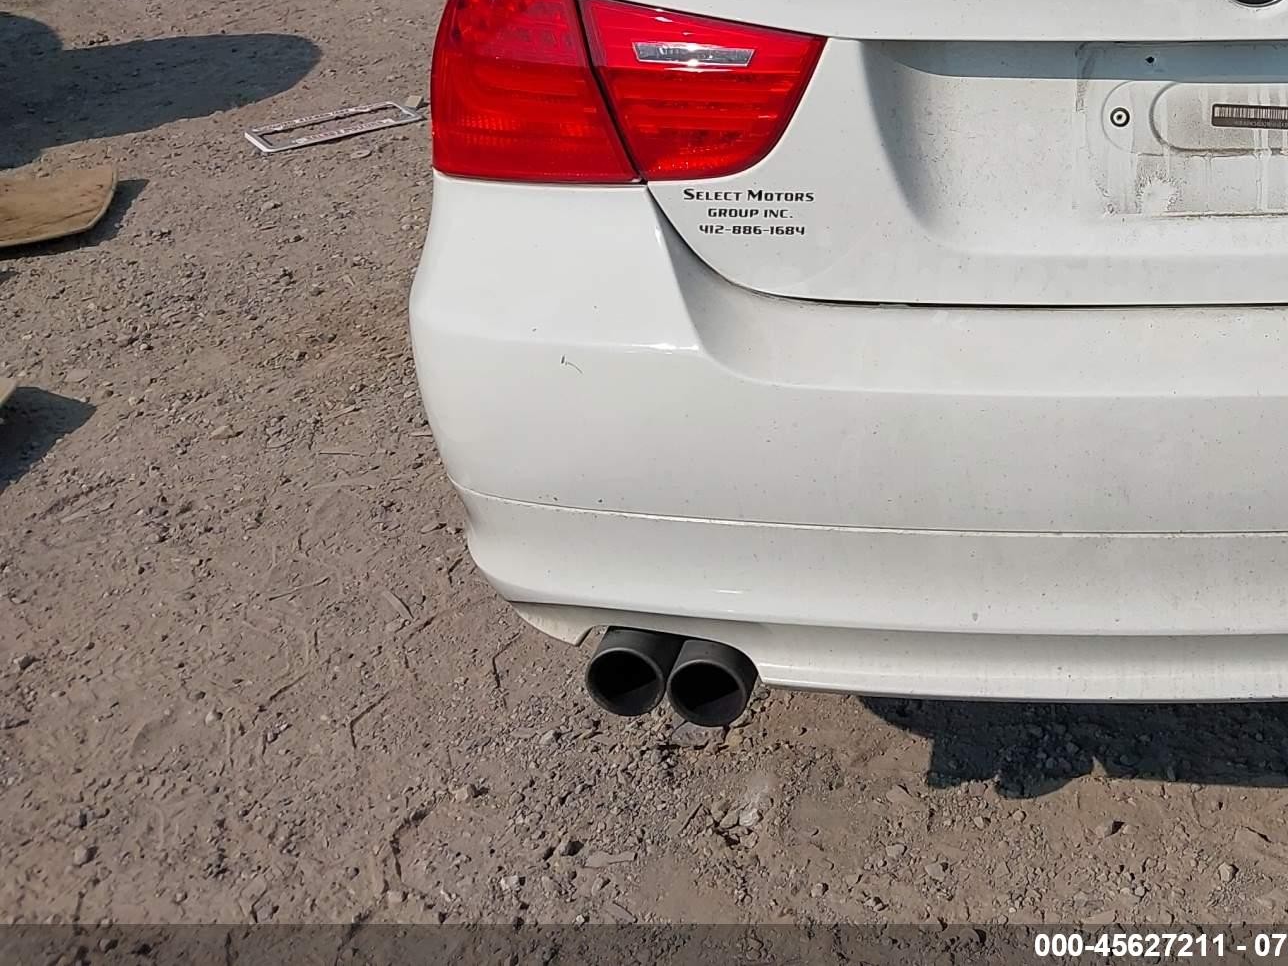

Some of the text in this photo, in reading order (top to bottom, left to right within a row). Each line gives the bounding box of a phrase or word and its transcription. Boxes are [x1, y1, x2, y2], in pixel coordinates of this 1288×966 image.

[707, 208, 793, 219] GROUP INC.
[699, 224, 805, 235] 412-886-1684
